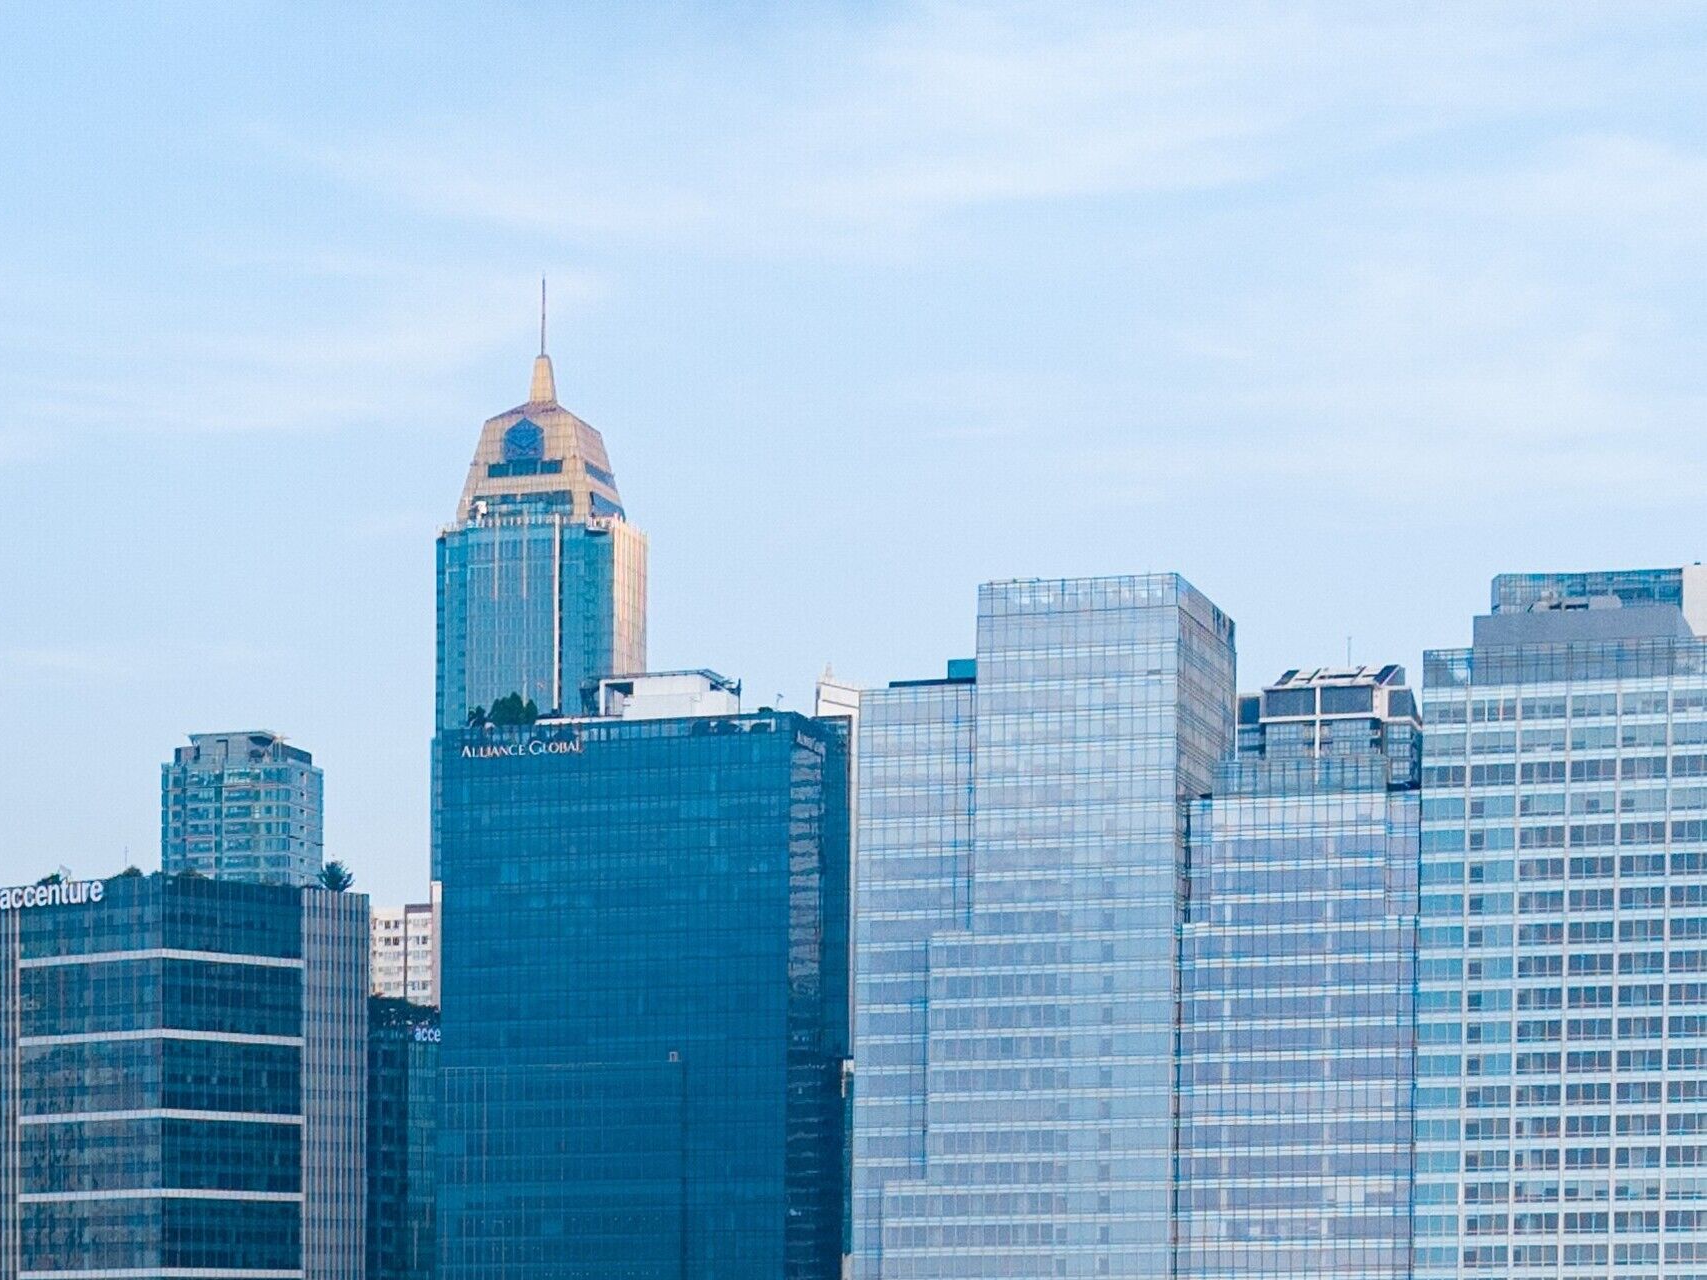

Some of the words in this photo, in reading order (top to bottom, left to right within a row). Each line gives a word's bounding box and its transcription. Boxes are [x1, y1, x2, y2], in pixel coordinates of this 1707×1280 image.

[461, 744, 526, 758] ALLIANCE
[528, 739, 584, 755] GLOBAL
[414, 1025, 442, 1042] acce
